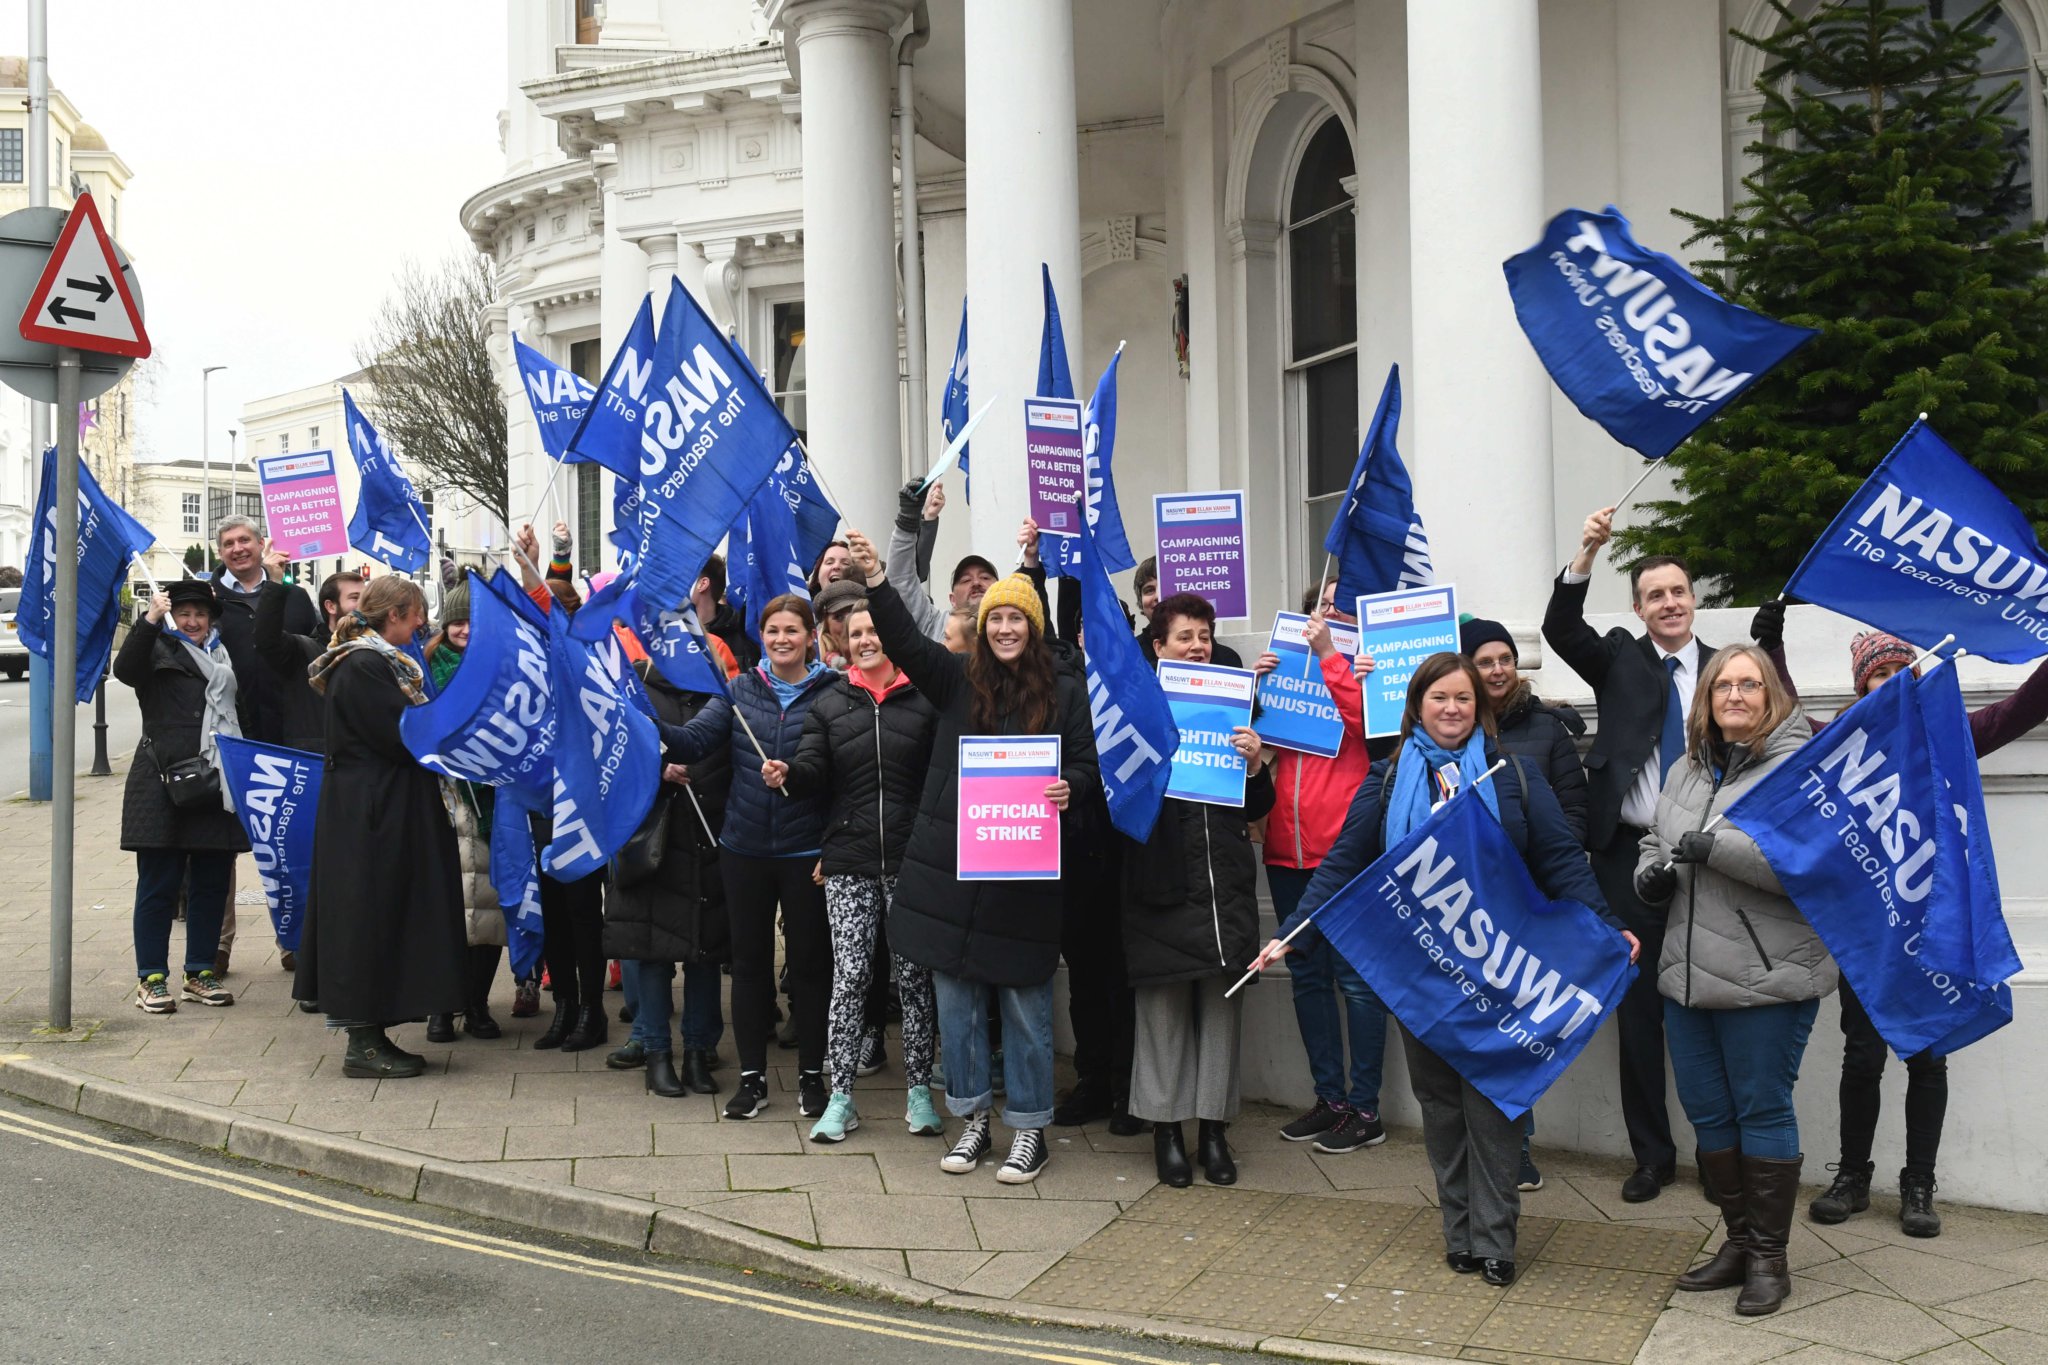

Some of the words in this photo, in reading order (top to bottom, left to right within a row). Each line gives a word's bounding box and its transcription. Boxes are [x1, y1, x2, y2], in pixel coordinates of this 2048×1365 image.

[527, 370, 598, 406] NAS
[606, 389, 636, 422] The
[537, 410, 558, 423] he
[1029, 444, 1082, 459] CAMPAIGNING
[1031, 459, 1046, 470] FOR
[1047, 461, 1053, 471] A
[1054, 462, 1081, 474] BETTER
[1039, 475, 1058, 486] DEAL
[1059, 477, 1075, 488] FOR
[267, 485, 336, 502] CAMPAIGNING
[1039, 490, 1077, 504] TEACHERS
[271, 505, 291, 514] FOR
[293, 503, 300, 511] A
[301, 498, 337, 510] BETTER
[283, 515, 308, 525] DEAL
[309, 511, 329, 520] FOR
[283, 523, 333, 537] TEACHERS
[1161, 536, 1240, 549] CAMPAIGNING
[1857, 482, 2048, 613] NASUW
[1164, 554, 1186, 563] FOR
[1188, 553, 1197, 562] A
[1199, 551, 1239, 562] BETTER
[1176, 568, 1204, 577] DEAL
[1206, 566, 1229, 576] FOR
[1174, 581, 1231, 592] TEACHERS
[1843, 528, 1886, 563] The
[1891, 553, 2003, 606] Teachers'
[2001, 602, 2048, 645] Unio
[1366, 634, 1454, 655] CAMPAIGNING
[1375, 659, 1394, 670] OR
[1397, 658, 1406, 668] A
[1266, 674, 1332, 699] FIGHTIN
[1260, 692, 1343, 723] INJUSTICE
[1178, 728, 1234, 747] GHTIN
[1171, 750, 1243, 770] JUSTICE
[968, 804, 1050, 819] OFFICIAL
[1818, 726, 1936, 903] NASU
[976, 825, 1042, 841] STRIKE
[1799, 770, 1837, 819] The
[1837, 814, 1911, 928] Teachers'
[1394, 835, 1603, 1039] NASUWT
[1377, 875, 1411, 920] The
[1412, 917, 1502, 1013] Teachers'
[1497, 1012, 1555, 1062] Union
